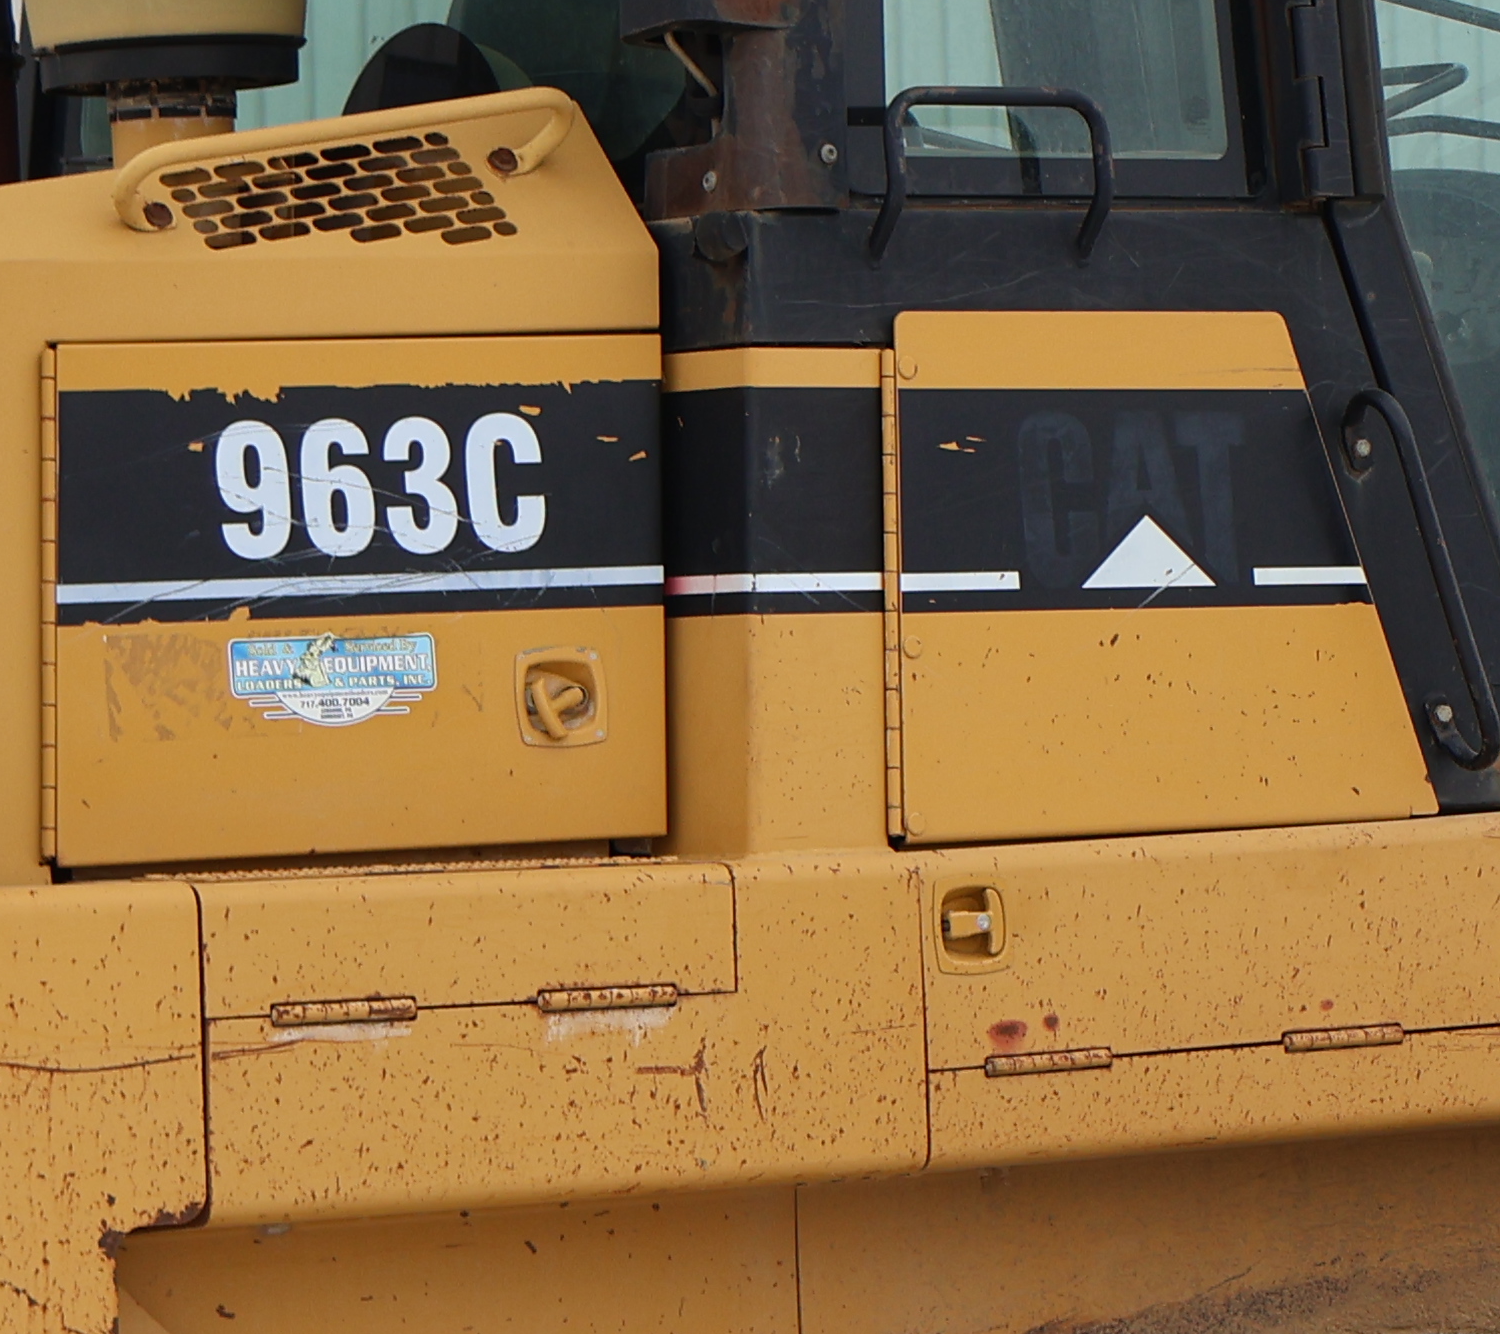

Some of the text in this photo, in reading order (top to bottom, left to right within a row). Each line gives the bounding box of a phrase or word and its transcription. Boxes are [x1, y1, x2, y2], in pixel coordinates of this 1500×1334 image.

[215, 412, 546, 560] 963C
[1017, 411, 1246, 589] CAT
[247, 638, 417, 656] Sold & Serviced By
[236, 653, 431, 677] HEAVY EQUIPMENT,
[237, 673, 431, 691] LOADERS & PARTS, INC.
[300, 696, 370, 708] 717.400.7004
